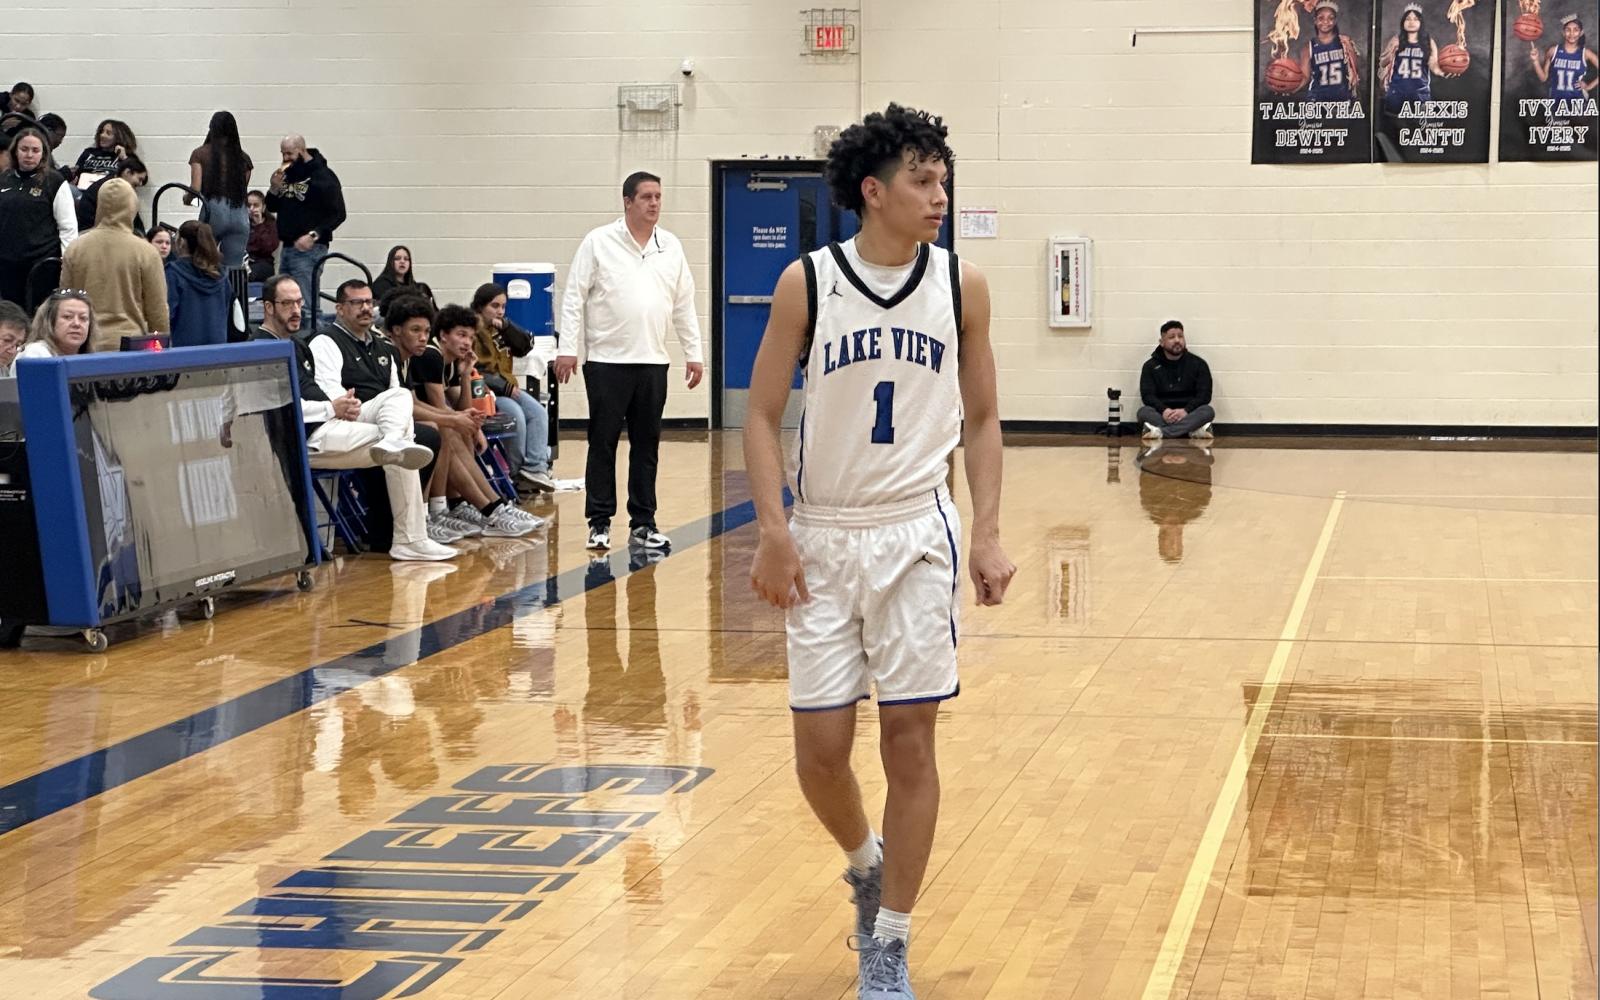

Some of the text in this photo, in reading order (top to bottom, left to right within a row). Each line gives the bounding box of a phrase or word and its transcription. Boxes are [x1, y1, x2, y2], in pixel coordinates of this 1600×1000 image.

[816, 27, 843, 48] EXIT
[1319, 62, 1342, 85] 15
[1398, 58, 1422, 78] 45
[1557, 70, 1574, 90] 11
[1260, 101, 1365, 119] TALISIYHA
[1398, 101, 1468, 118] ALEXIS
[1519, 99, 1599, 116] IVYANA
[1275, 128, 1348, 146] DEWITT
[1399, 128, 1465, 145] CANTU
[1529, 126, 1589, 144] IVERY
[752, 226, 768, 234] Please
[824, 327, 945, 376] LAKE VIEW
[473, 385, 483, 396] G
[871, 381, 895, 444] 1
[87, 762, 716, 1000] CHIEFS
